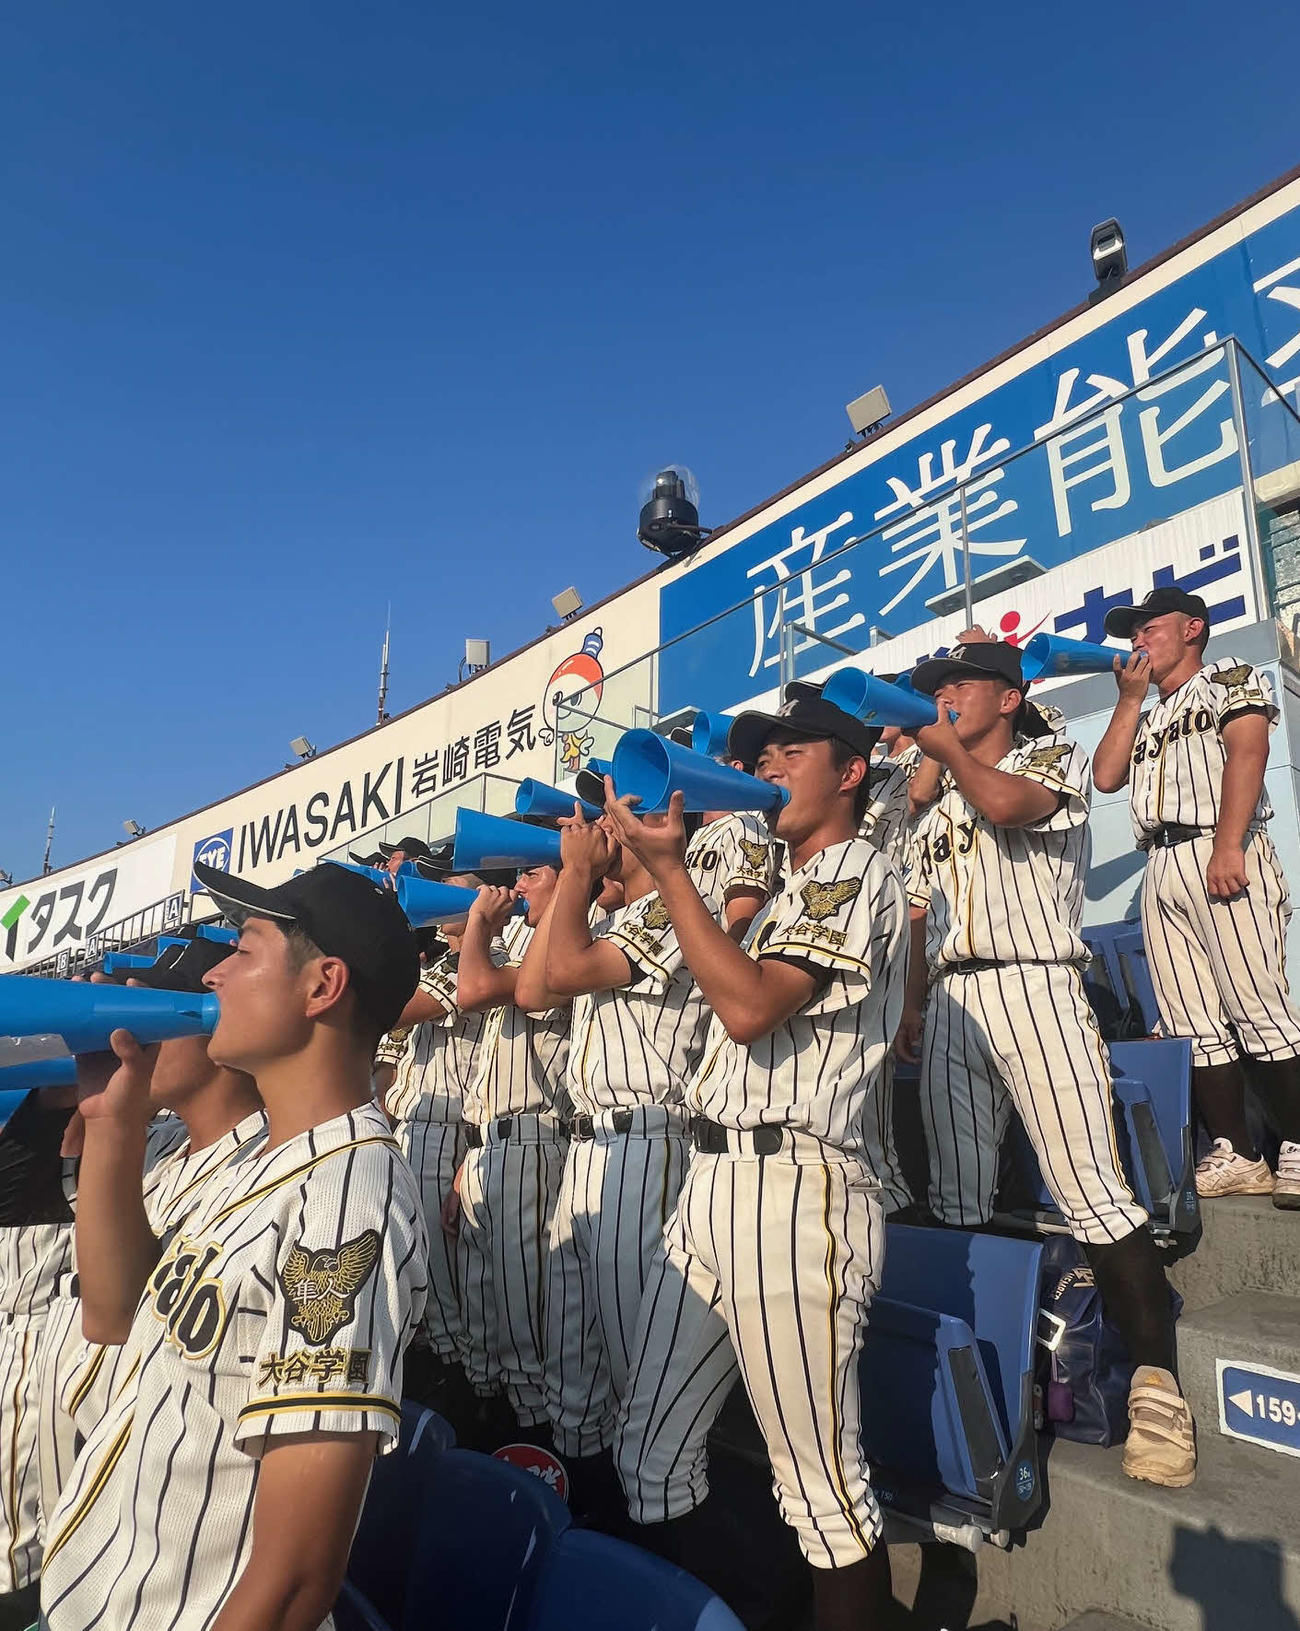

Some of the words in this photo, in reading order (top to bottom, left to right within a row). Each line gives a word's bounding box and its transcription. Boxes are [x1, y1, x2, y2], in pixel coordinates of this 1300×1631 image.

[238, 756, 404, 874] IWASAKI
[411, 704, 536, 798] 岩崎電気
[0, 867, 118, 962] イタスク
[778, 922, 847, 947] 大谷学園
[293, 1278, 350, 1305] 隼人
[256, 1347, 372, 1388] 大谷学園
